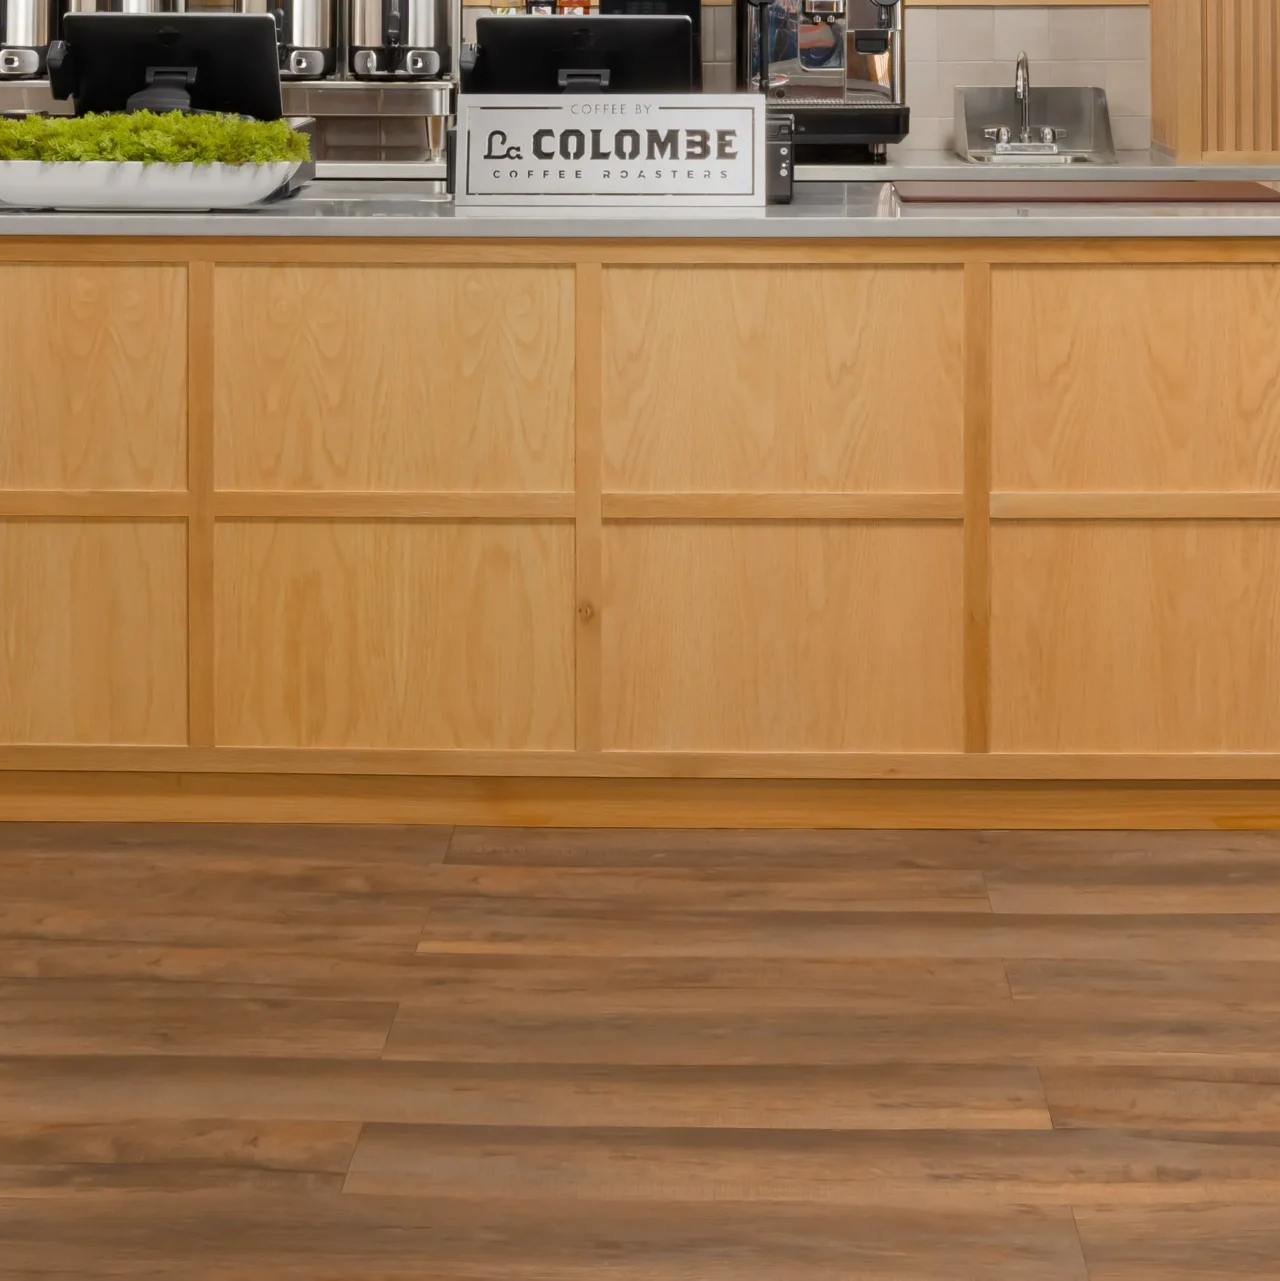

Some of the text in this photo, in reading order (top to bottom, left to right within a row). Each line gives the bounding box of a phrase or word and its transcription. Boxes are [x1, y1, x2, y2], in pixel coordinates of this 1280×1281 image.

[570, 103, 653, 115] COFFEE BY
[483, 128, 739, 160] La COLOMBE
[492, 169, 728, 179] COFFEE ROASTERS
